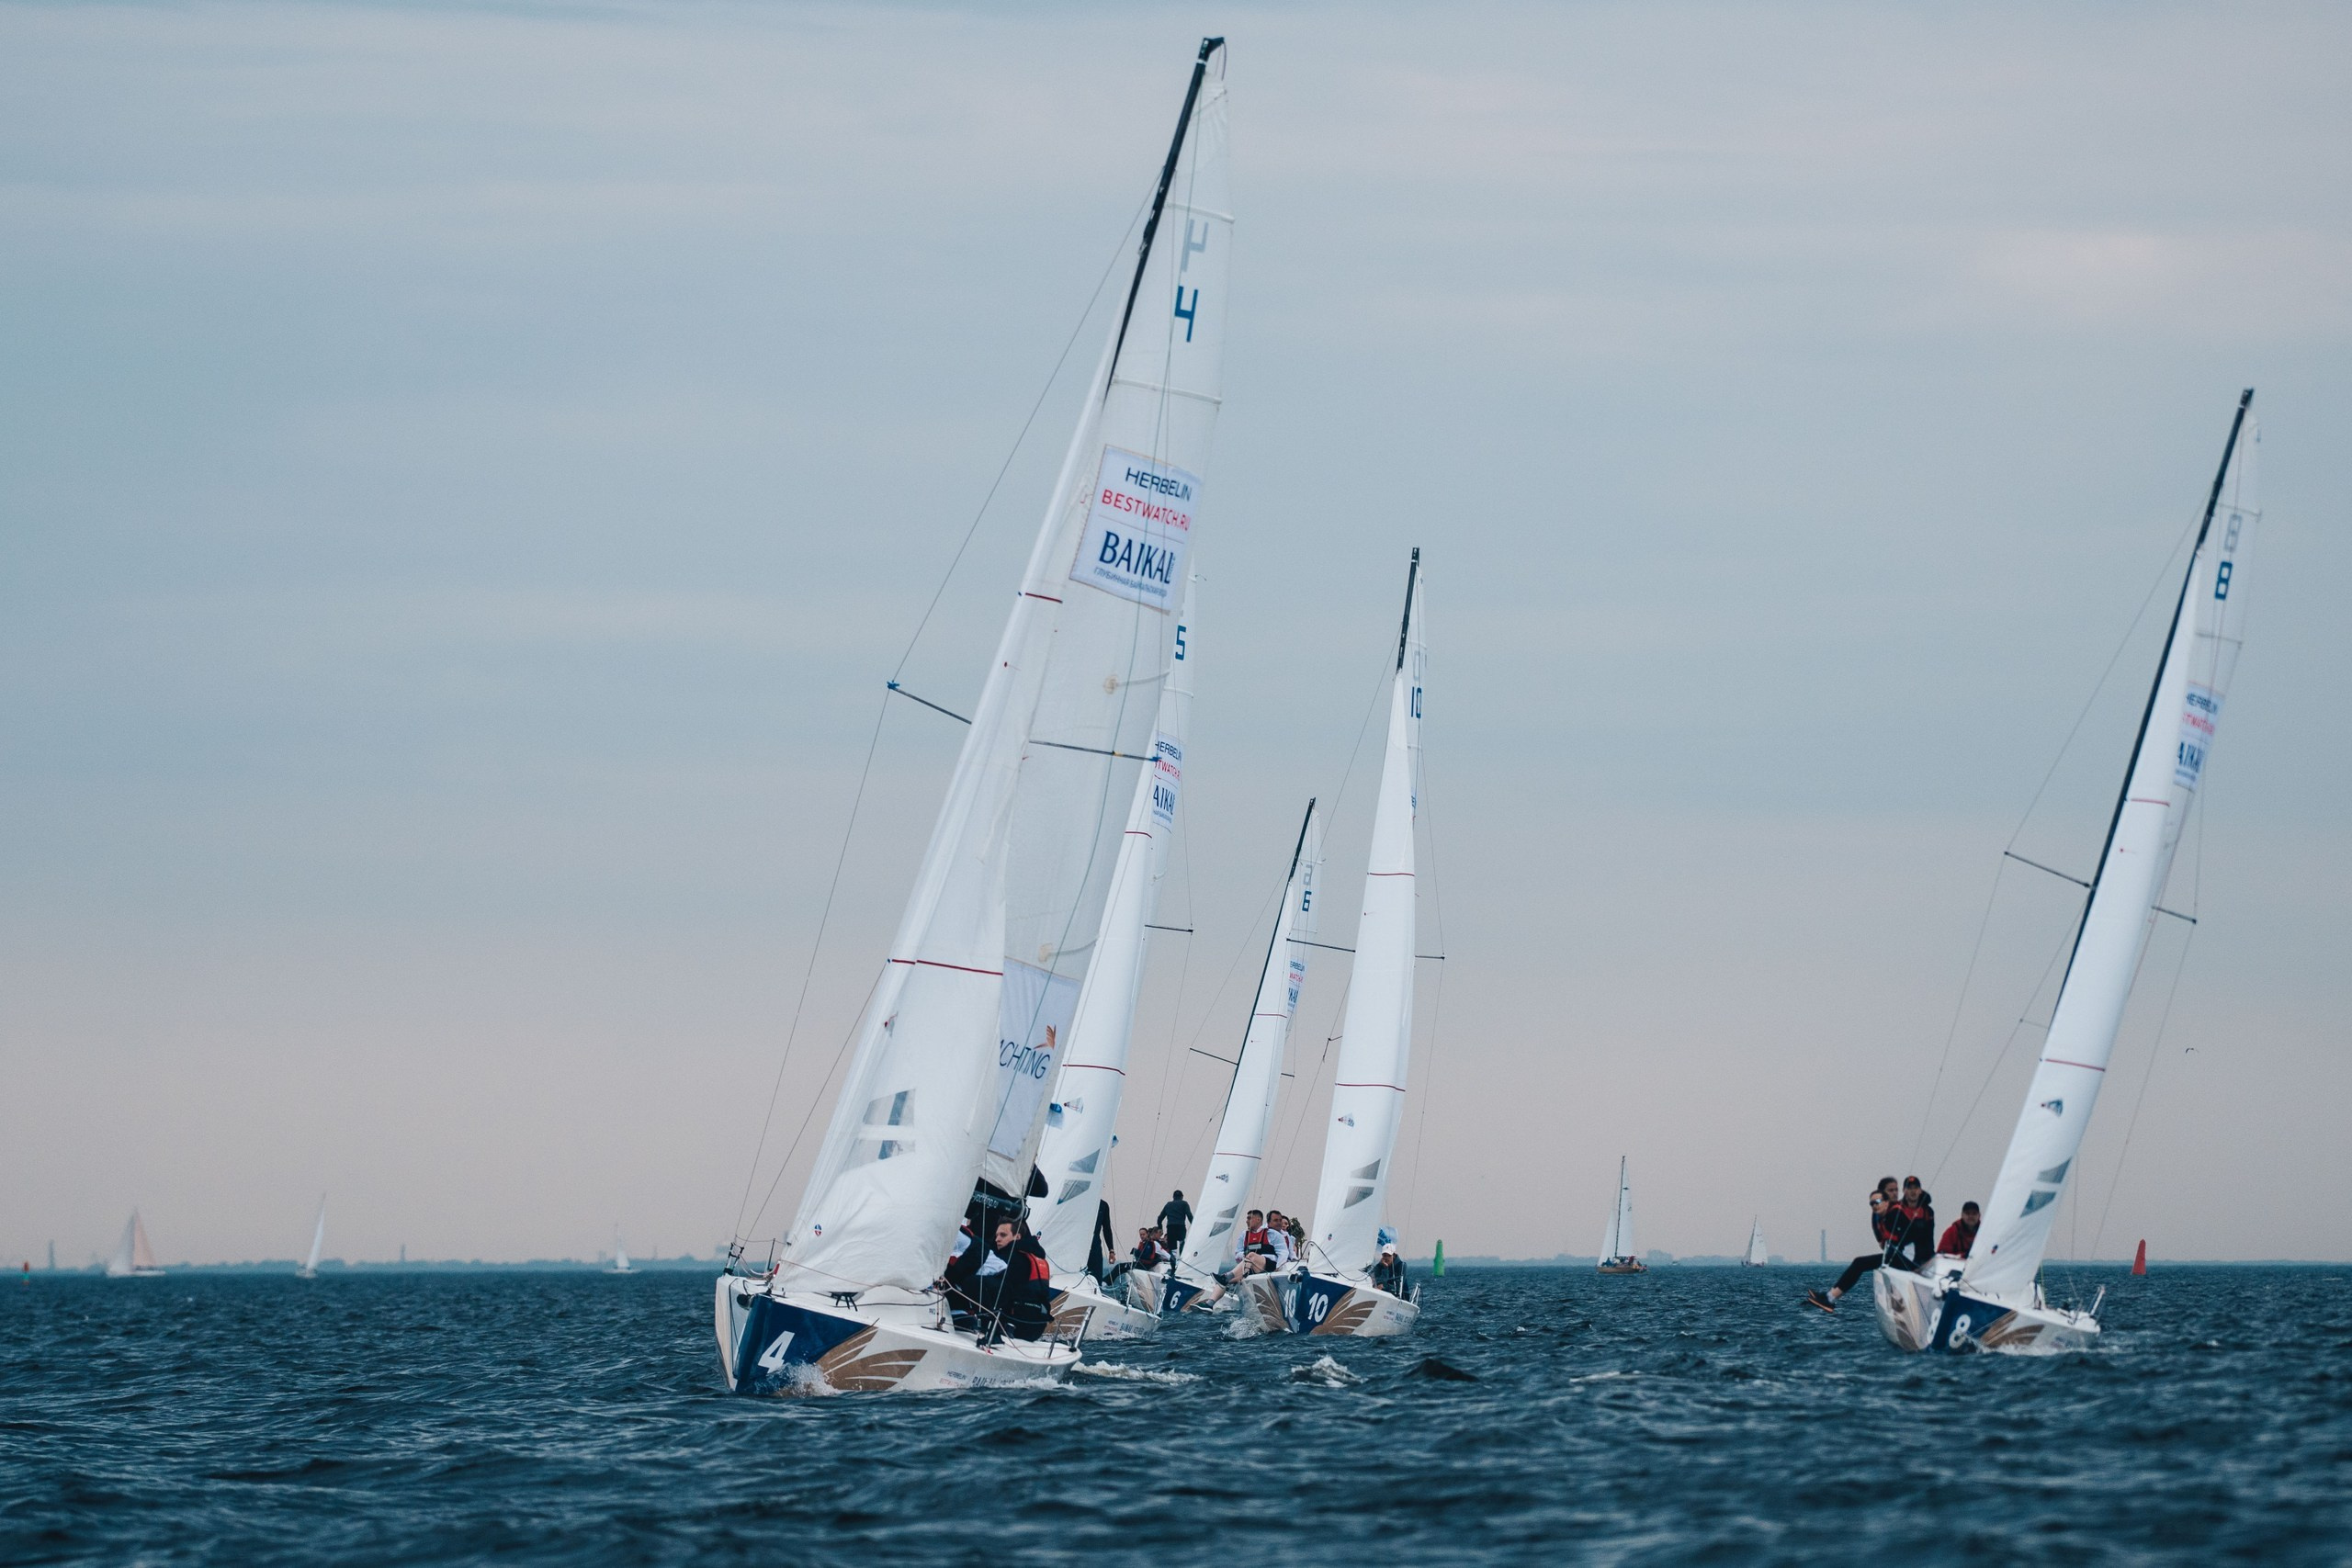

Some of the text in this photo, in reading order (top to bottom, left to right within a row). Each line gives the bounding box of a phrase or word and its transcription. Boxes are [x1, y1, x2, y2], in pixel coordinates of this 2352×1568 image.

[1174, 285, 1199, 344] 4
[1125, 467, 1193, 502] HERBELIN
[1101, 489, 1192, 532] BESTWATCH.RU
[1099, 530, 1174, 585] BAIKAL
[2214, 560, 2233, 601] 8
[1174, 625, 1187, 661] 5
[1410, 686, 1422, 719] 10
[1301, 890, 1313, 912] 6
[1000, 1039, 1051, 1079] CHTING
[1170, 1291, 1182, 1309] 6
[1283, 1289, 1297, 1318] 10
[1307, 1292, 1329, 1323] 10
[1926, 1307, 1942, 1345] 8
[1949, 1314, 1972, 1349] 8
[757, 1330, 796, 1375] 4
